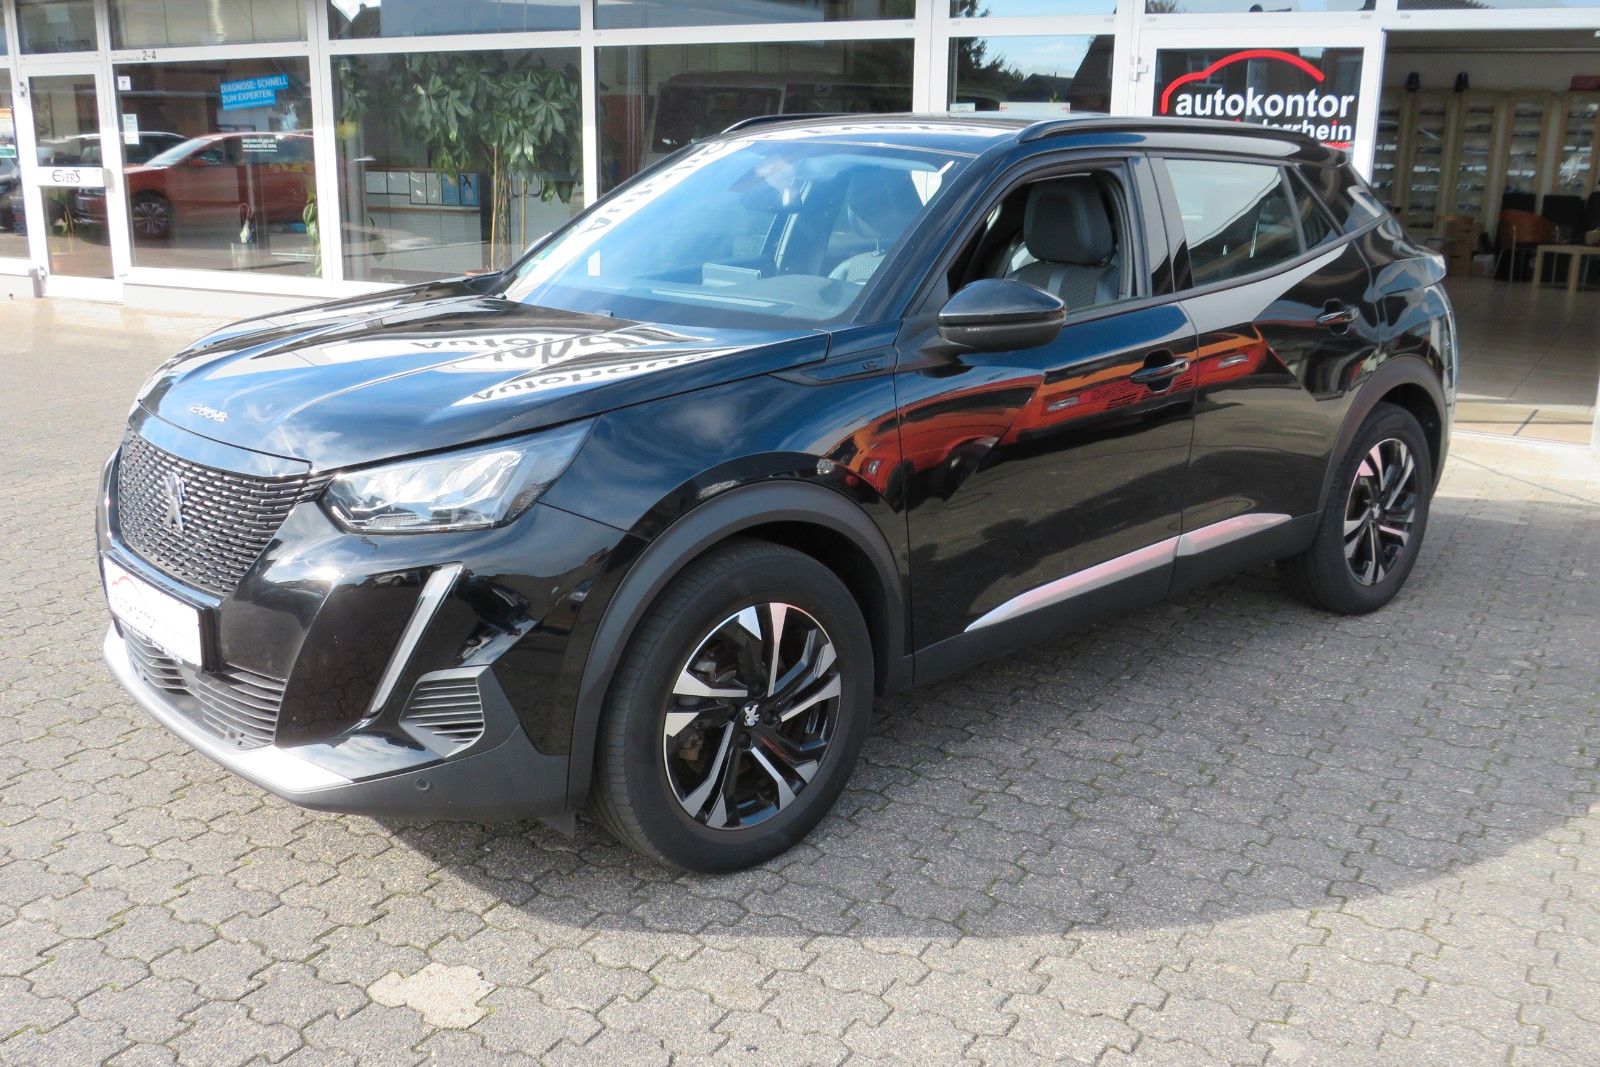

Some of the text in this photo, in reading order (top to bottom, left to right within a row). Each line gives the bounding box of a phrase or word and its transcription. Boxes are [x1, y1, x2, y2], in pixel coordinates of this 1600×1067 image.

[257, 77, 287, 87] SCHNELL
[222, 93, 237, 103] ZUM
[1175, 87, 1355, 118] autokontor
